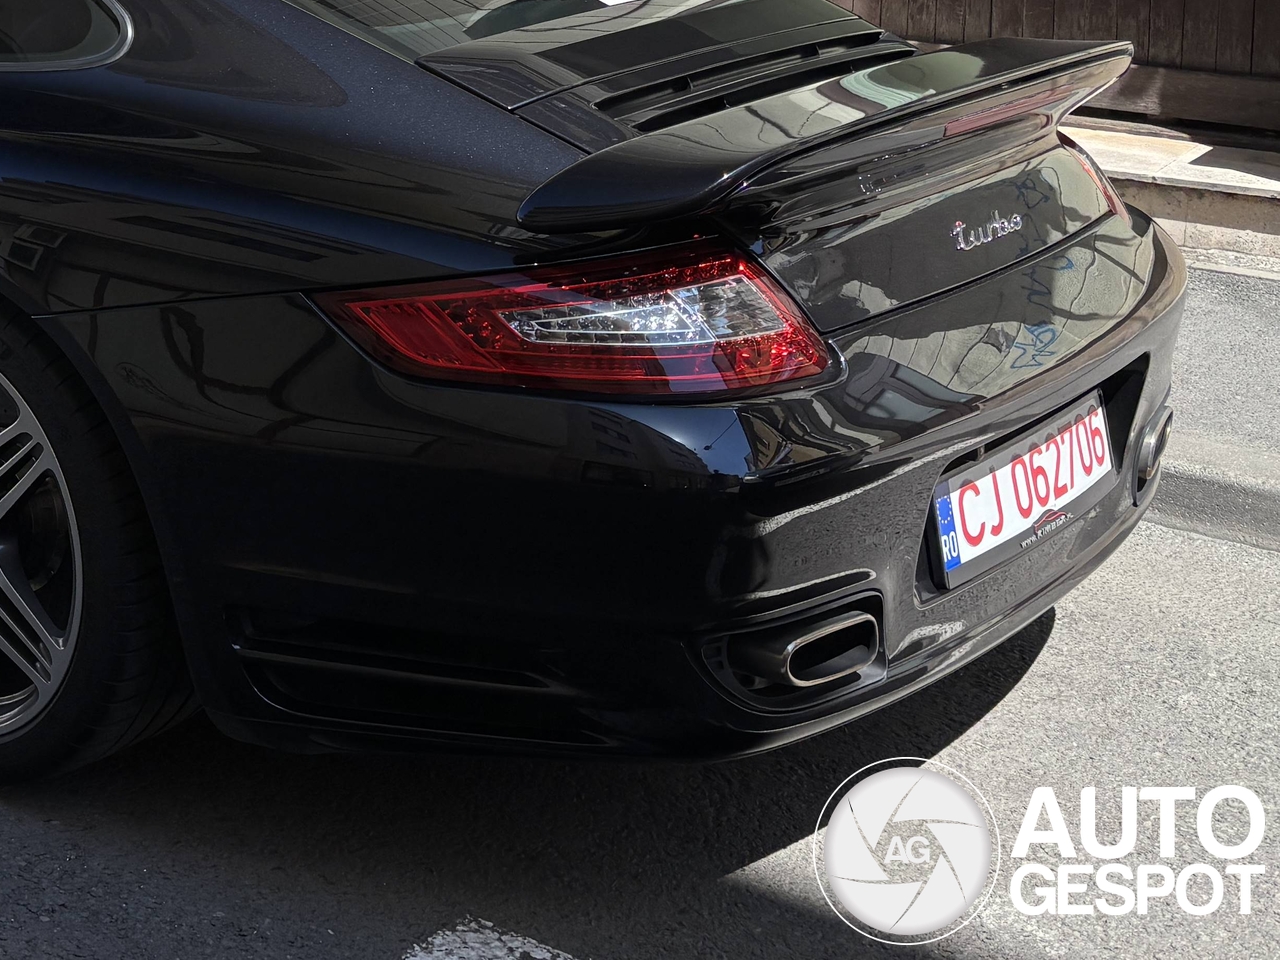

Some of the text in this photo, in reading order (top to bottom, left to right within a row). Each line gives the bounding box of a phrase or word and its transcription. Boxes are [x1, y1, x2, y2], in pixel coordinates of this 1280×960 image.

[950, 209, 1022, 251] turbo
[958, 405, 1105, 547] CJ 062706
[941, 531, 958, 563] RO
